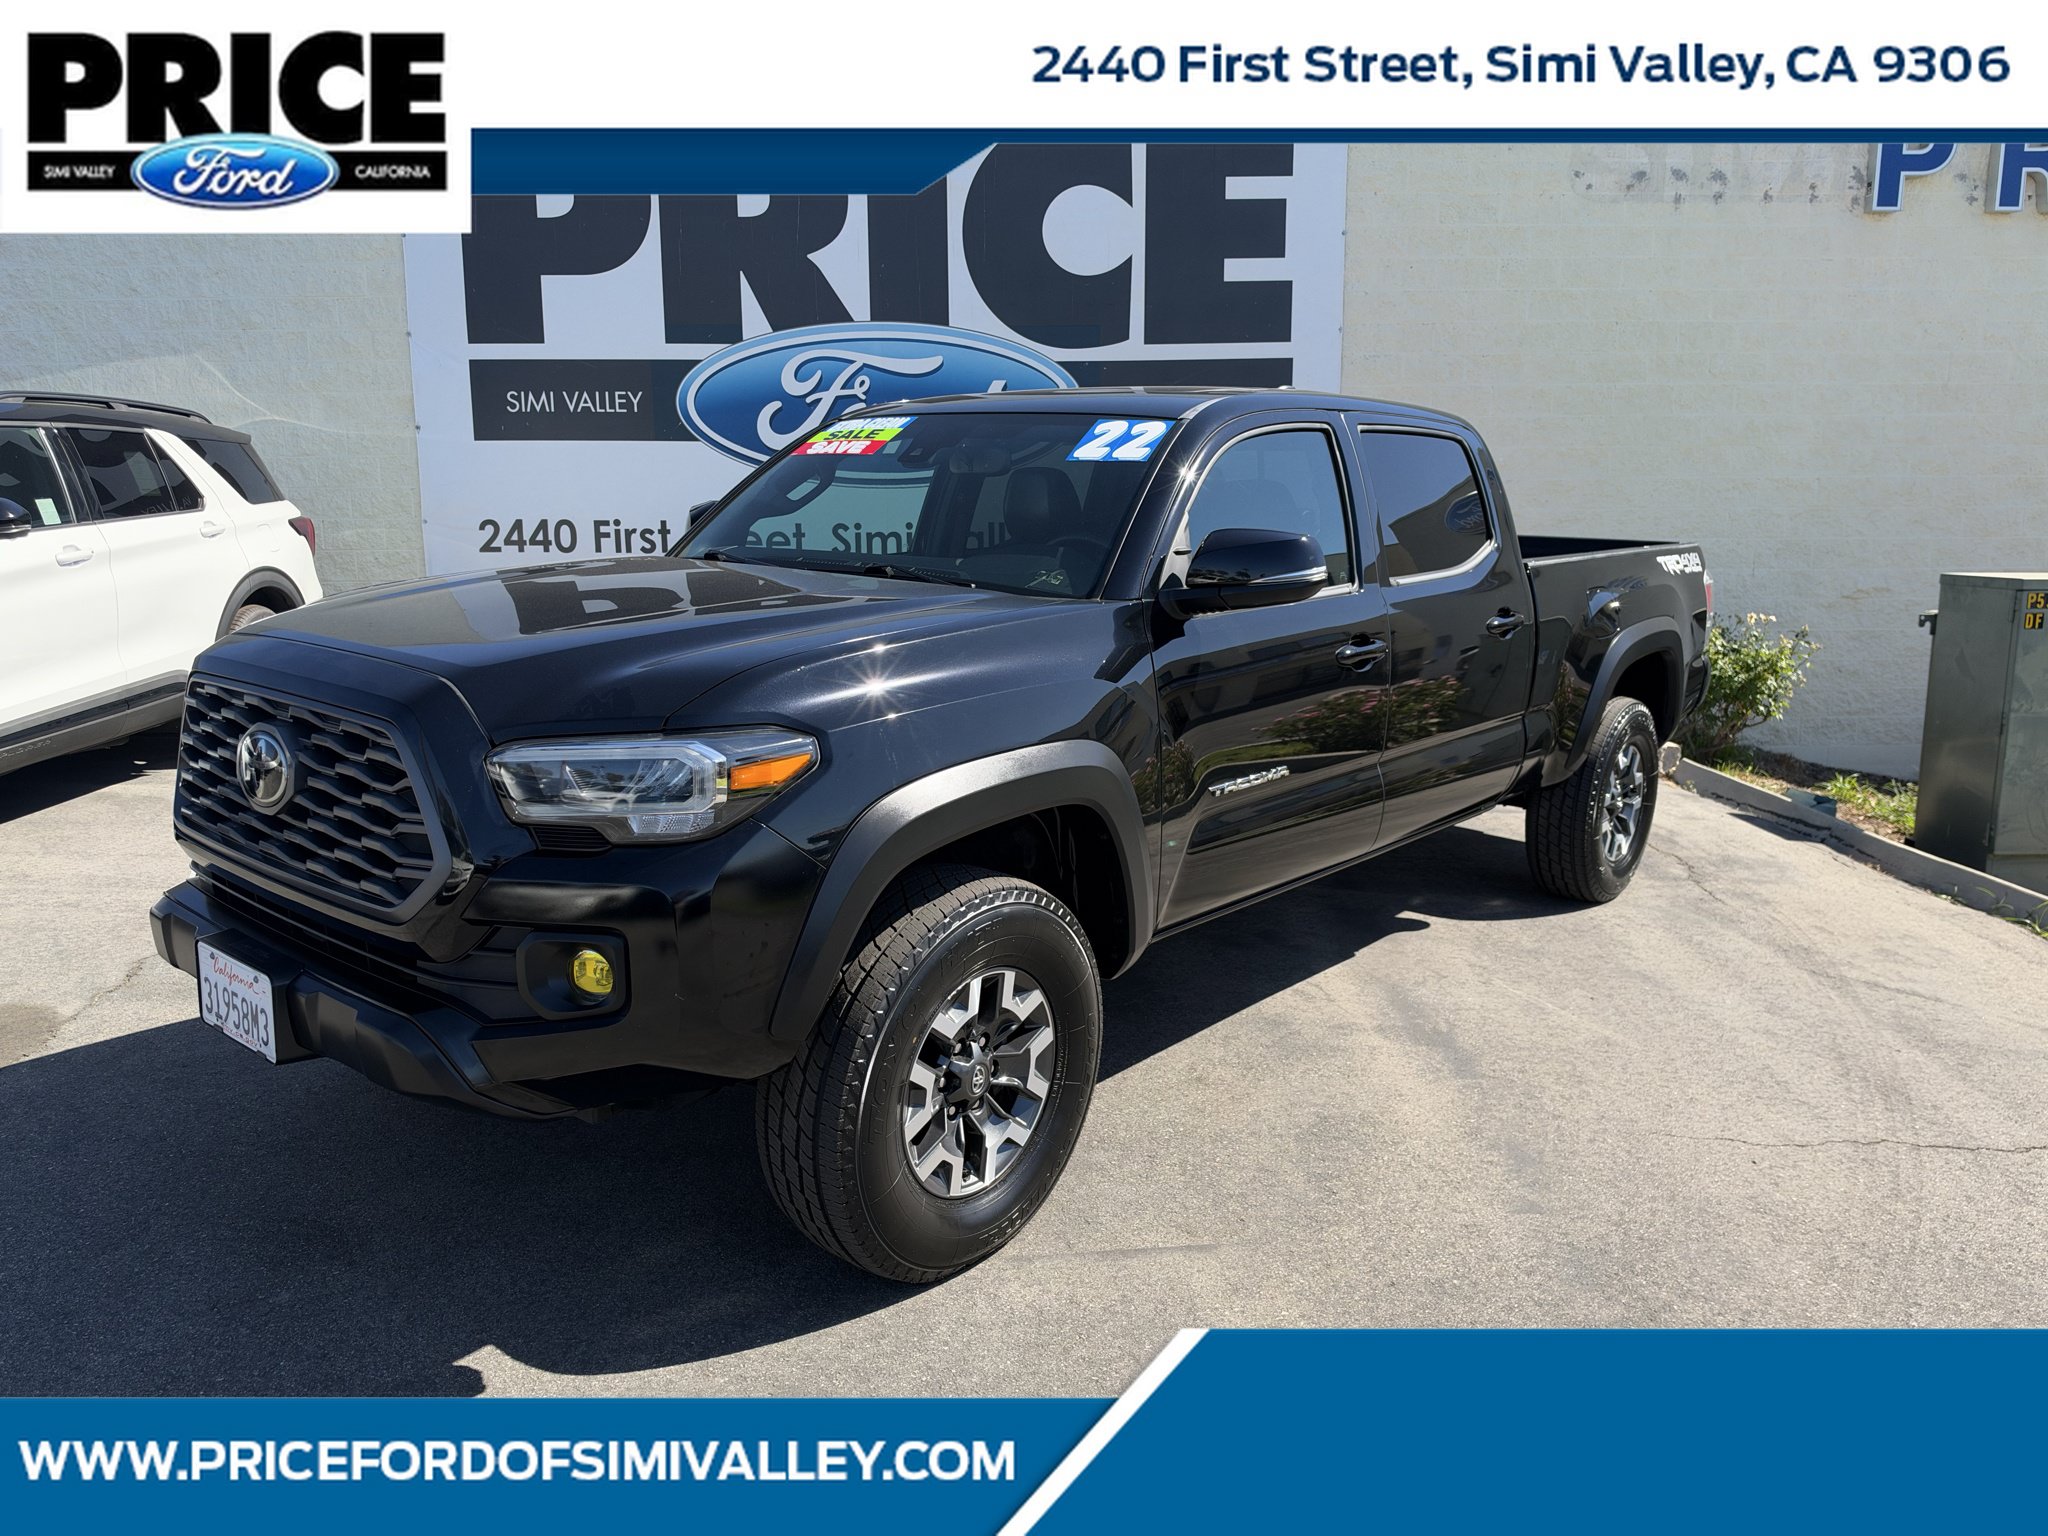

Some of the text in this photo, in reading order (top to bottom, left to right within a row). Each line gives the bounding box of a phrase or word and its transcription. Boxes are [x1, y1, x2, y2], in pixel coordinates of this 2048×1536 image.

[463, 143, 1294, 348] PRICE
[506, 390, 643, 413] SIMI VALLEY
[806, 441, 872, 454] SAVE
[824, 429, 884, 440] SALE
[1073, 420, 1168, 460] 22
[478, 518, 578, 554] 2440
[593, 518, 671, 555] First
[2026, 591, 2048, 609] P5
[1207, 765, 1290, 797] TACOMA
[203, 976, 269, 1047] 31958M3
